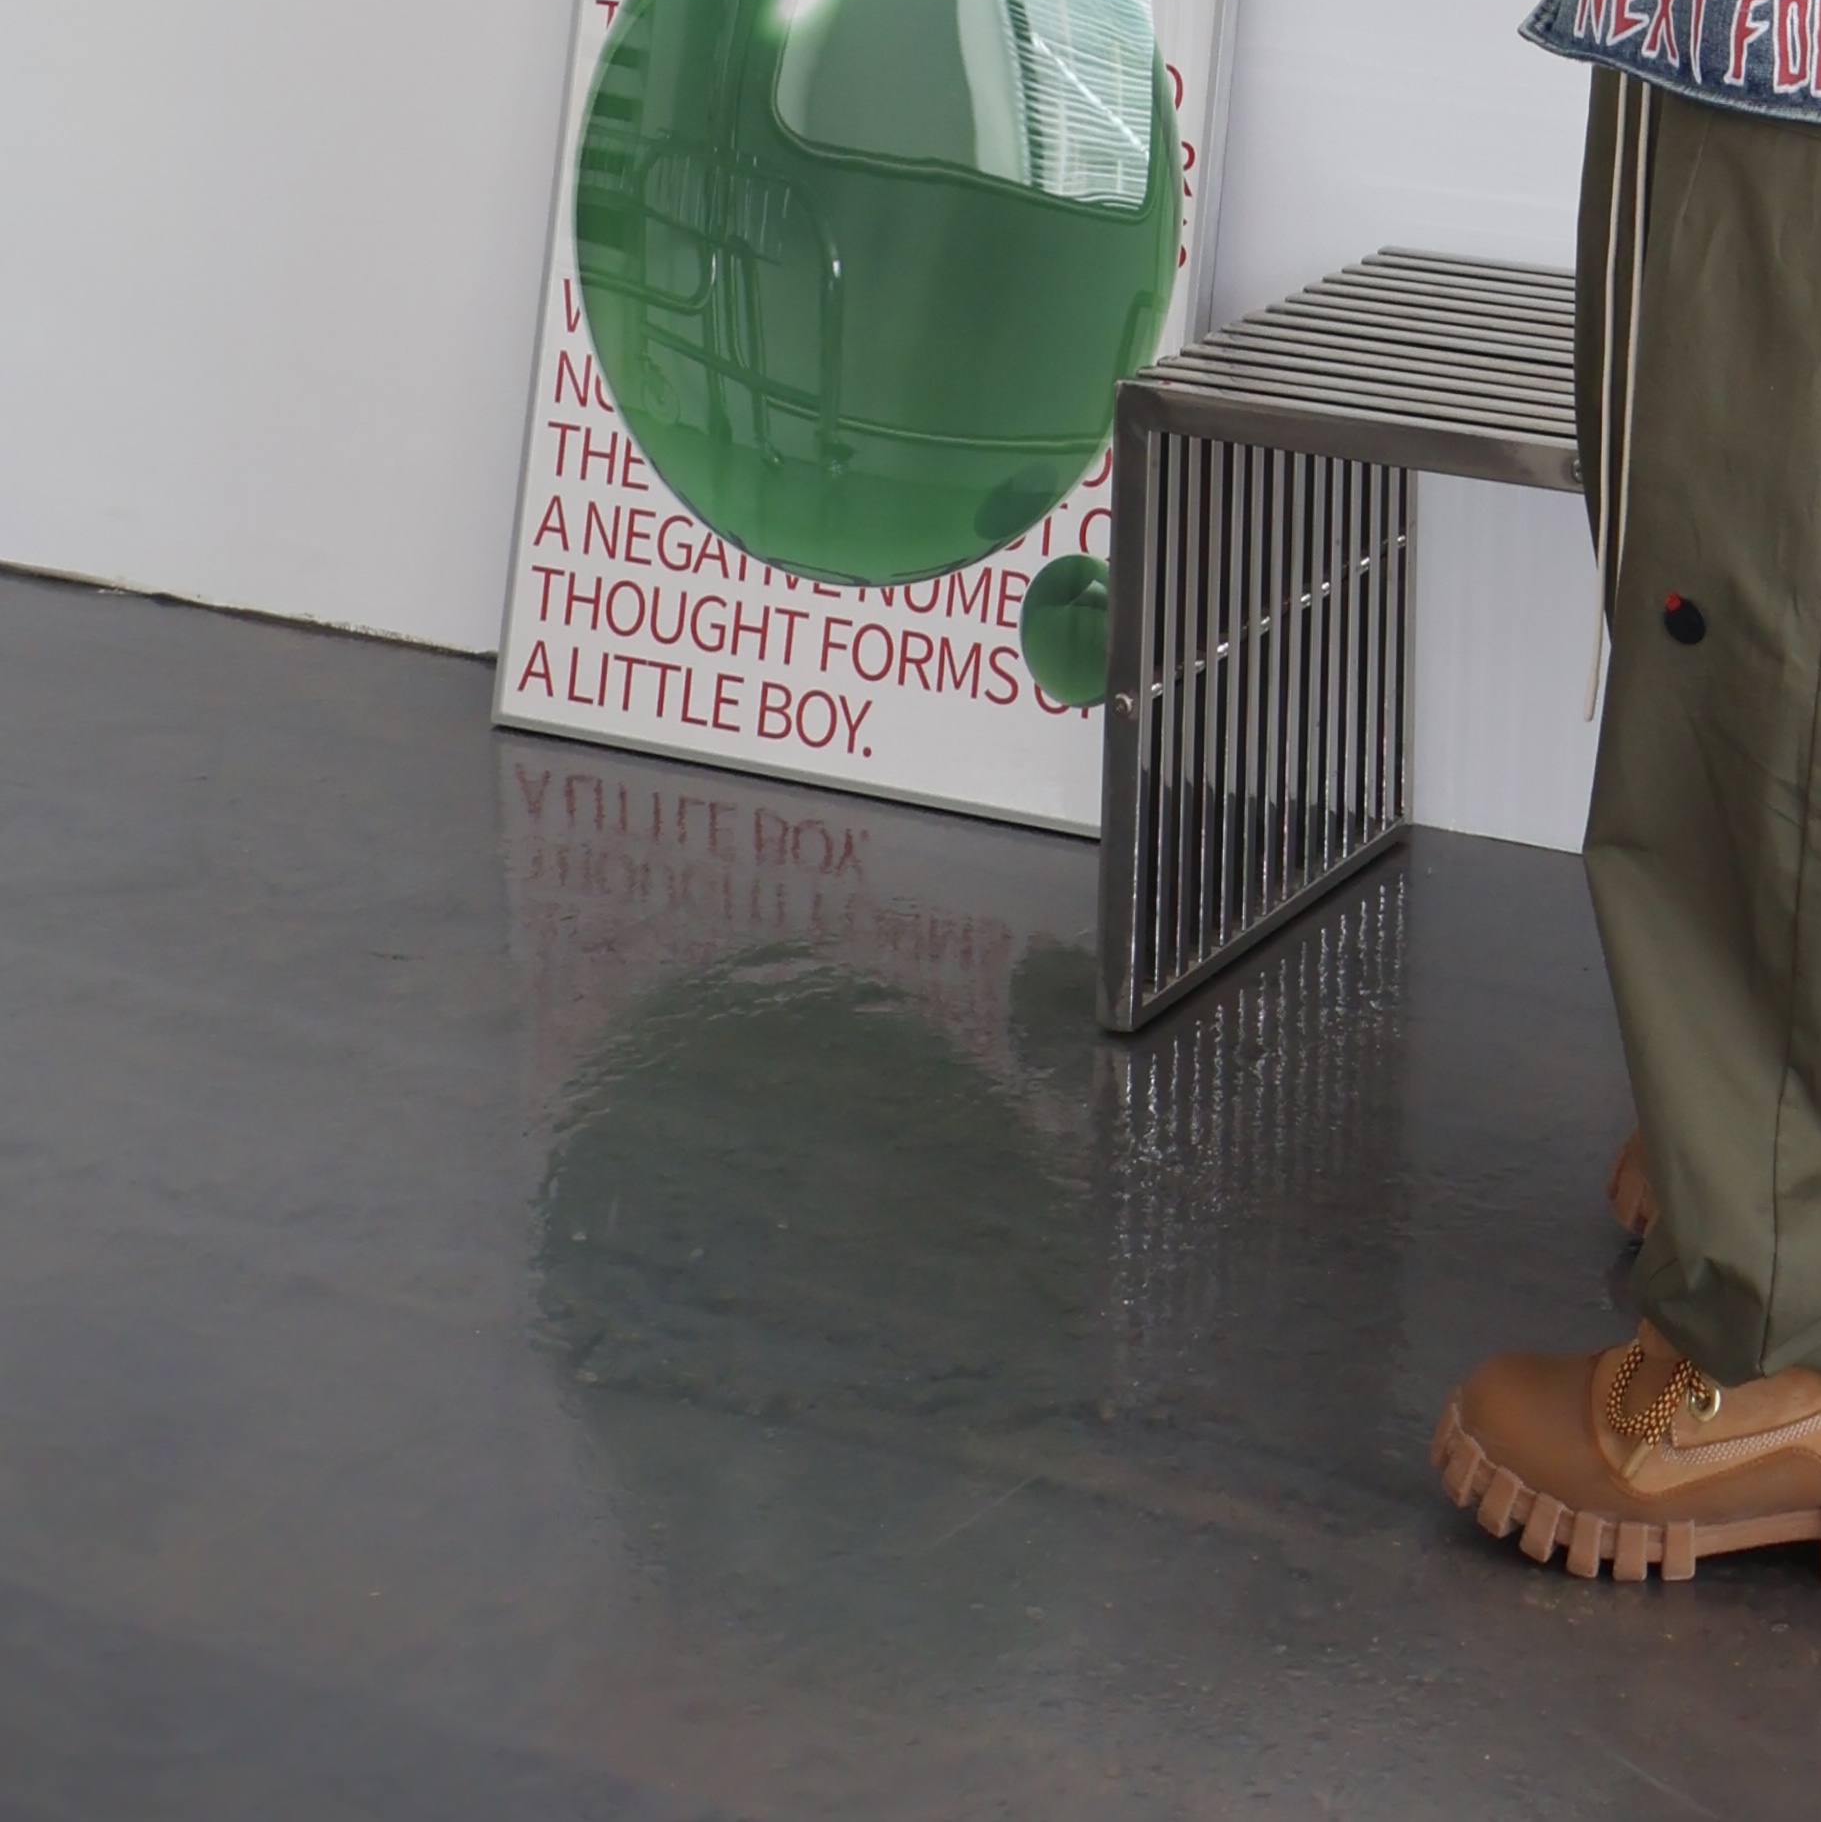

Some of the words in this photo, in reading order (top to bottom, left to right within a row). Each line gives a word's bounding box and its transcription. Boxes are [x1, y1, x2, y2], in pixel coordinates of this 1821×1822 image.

[547, 420, 649, 491] THE
[533, 494, 570, 552] A
[531, 564, 810, 665] THOUGHT
[819, 616, 1020, 706] FORMS
[518, 640, 554, 697] A
[567, 646, 745, 733] LITTLE
[757, 680, 873, 759] BOY.
